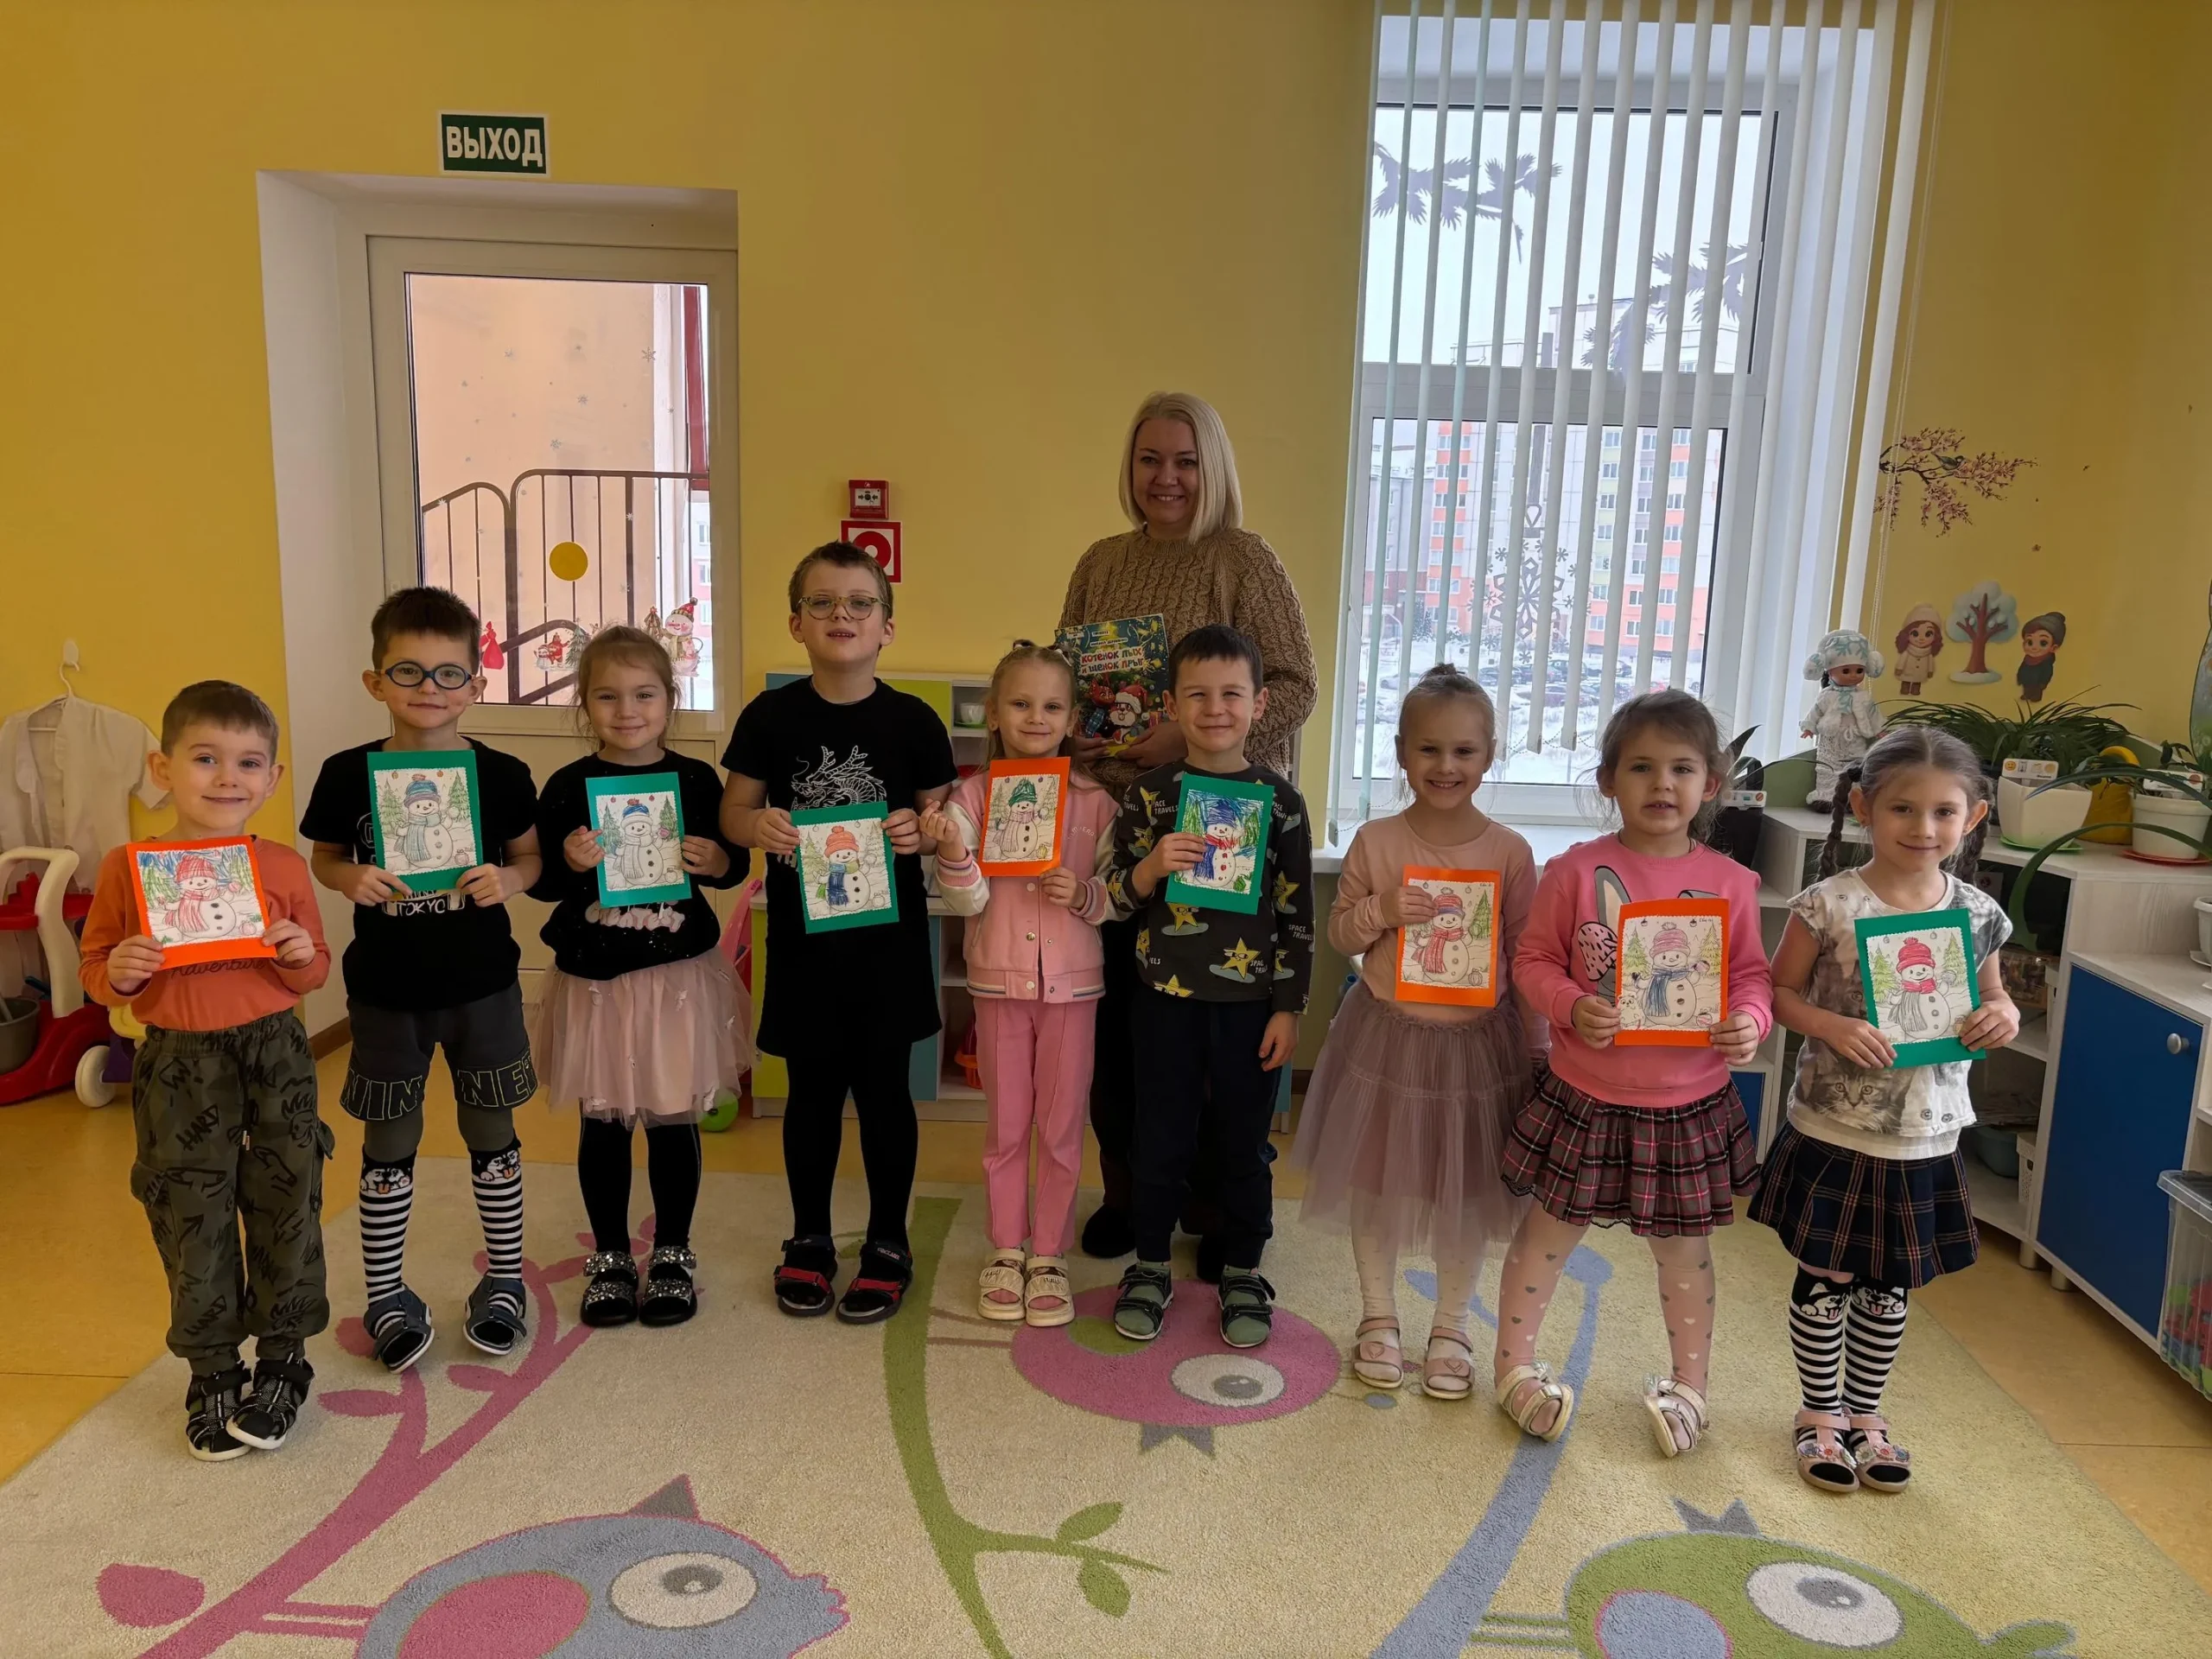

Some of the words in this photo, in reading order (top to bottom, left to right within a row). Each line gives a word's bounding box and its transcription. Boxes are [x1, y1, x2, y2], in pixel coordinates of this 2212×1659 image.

[446, 125, 543, 168] ВЫХОД
[397, 899, 446, 917] TOKYO
[1287, 924, 1306, 933] SPACE
